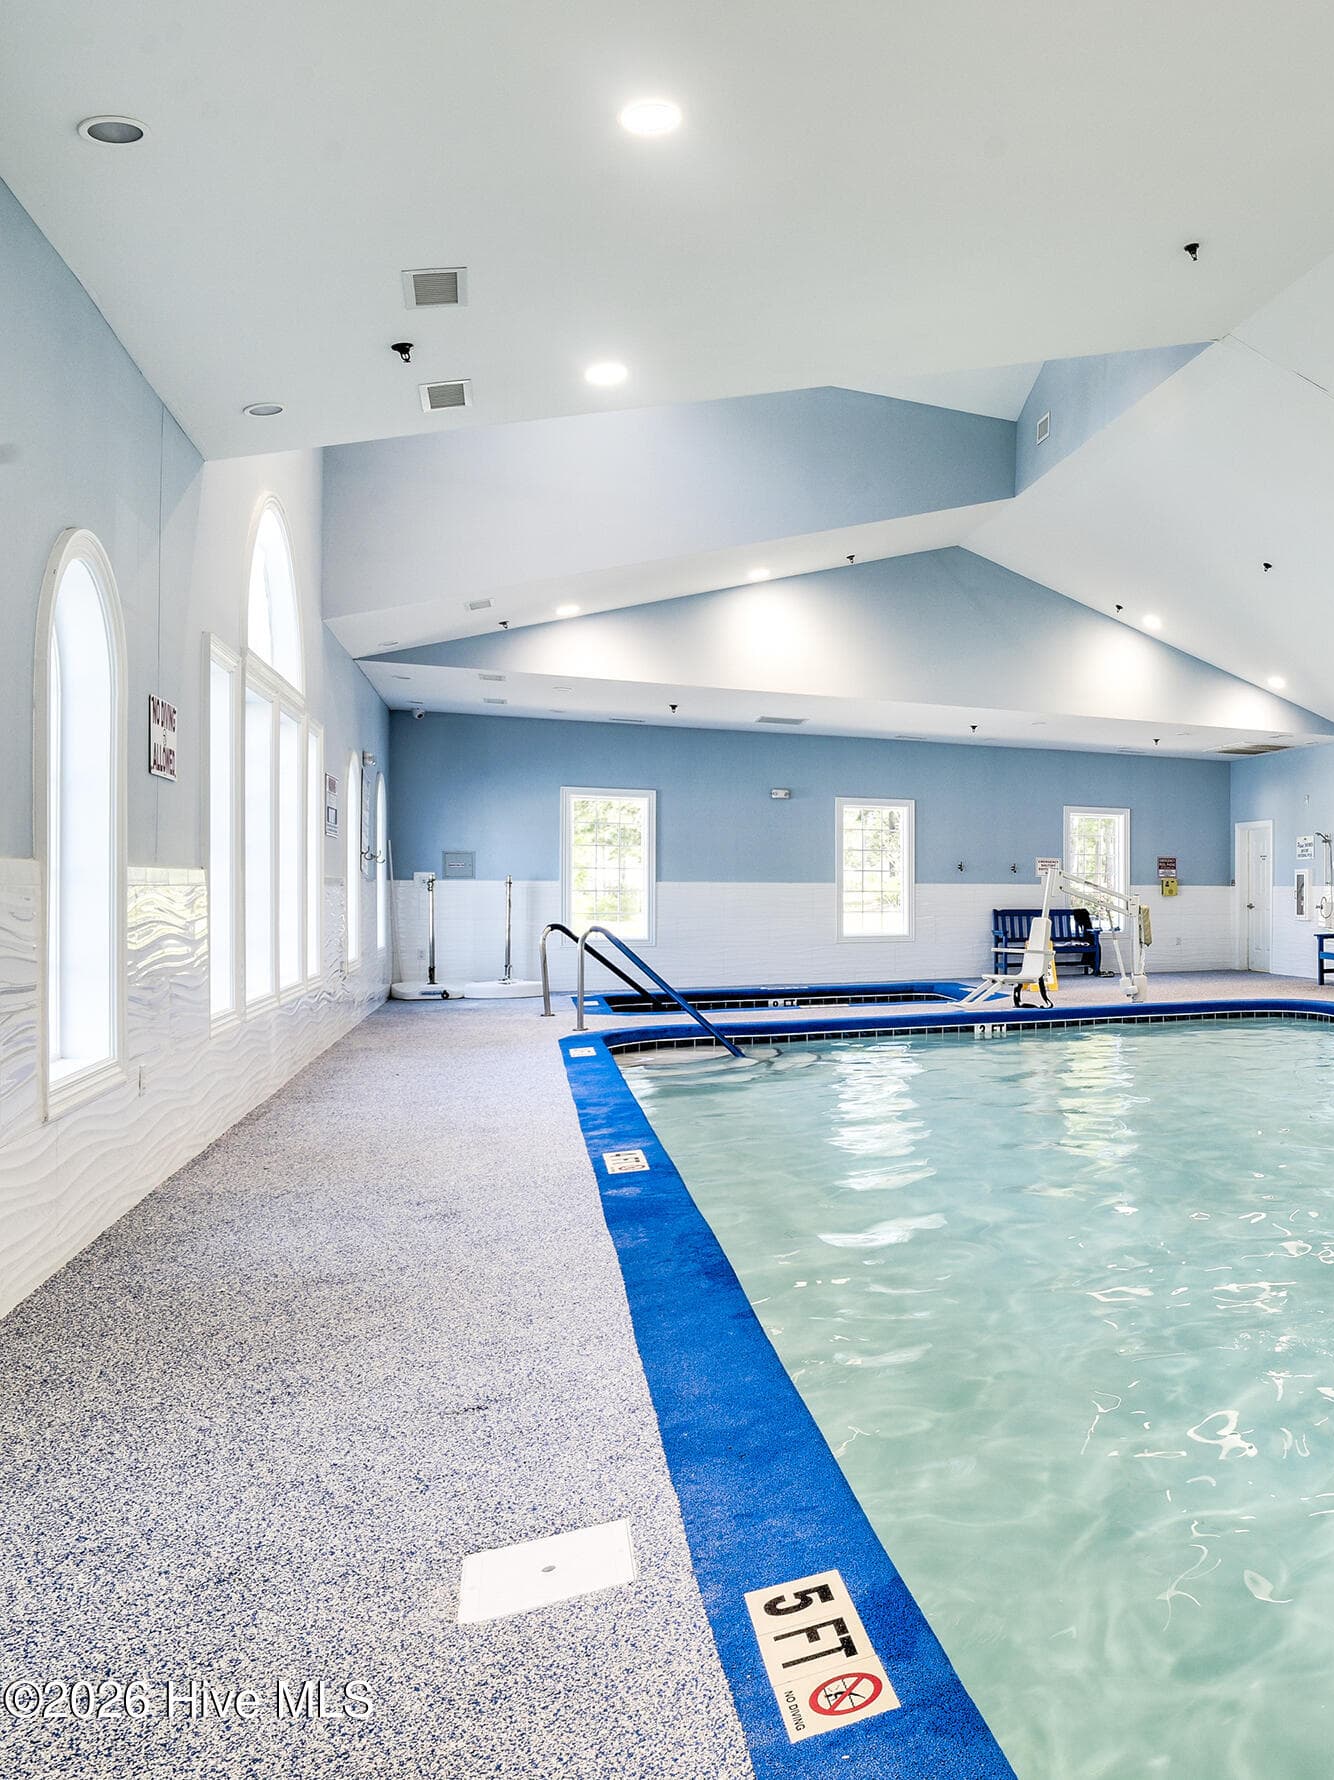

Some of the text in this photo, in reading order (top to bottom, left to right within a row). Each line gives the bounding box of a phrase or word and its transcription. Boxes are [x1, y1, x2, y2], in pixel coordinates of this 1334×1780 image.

[763, 1584, 859, 1669] 5 FT
[784, 1690, 806, 1732] NO DIVING
